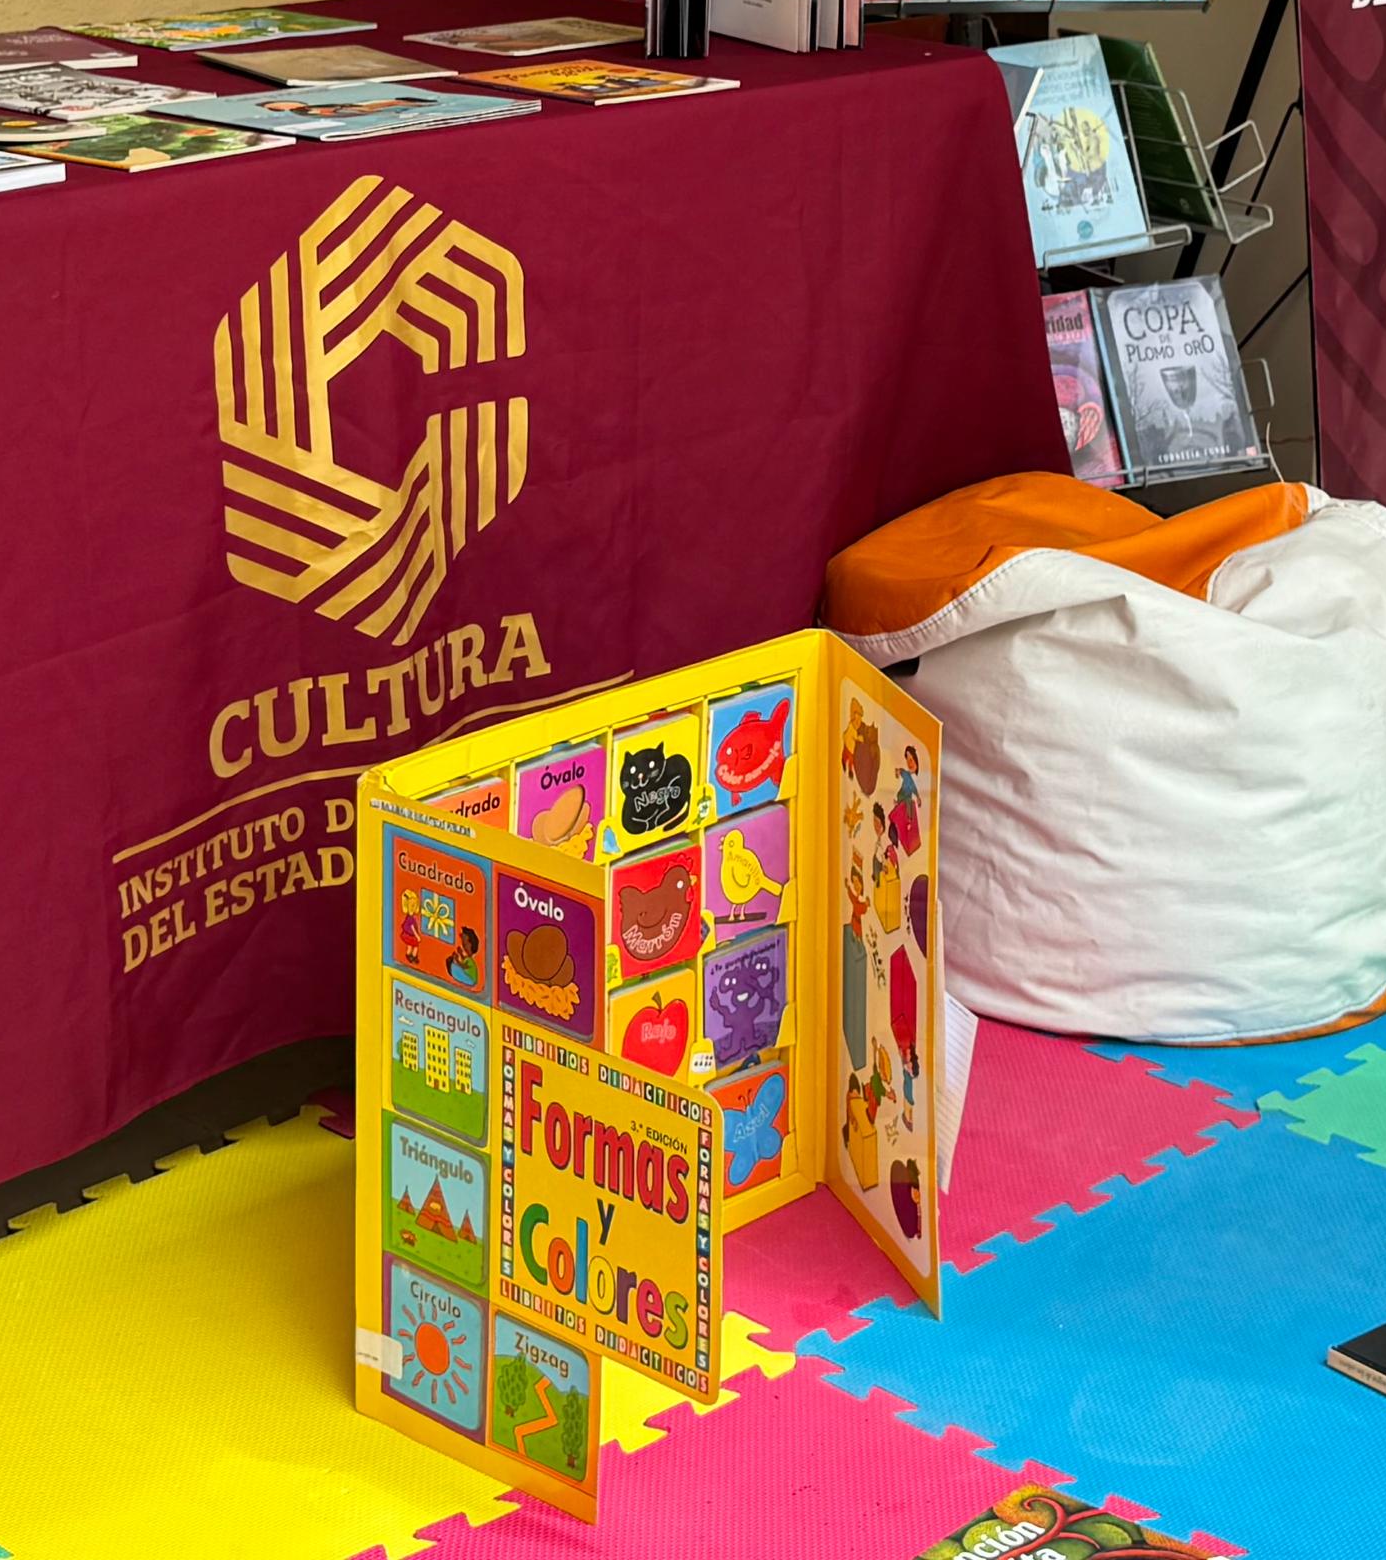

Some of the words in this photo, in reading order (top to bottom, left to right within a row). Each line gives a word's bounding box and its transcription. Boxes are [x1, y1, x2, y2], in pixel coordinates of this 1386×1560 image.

[1045, 312, 1084, 334] ridad
[1123, 300, 1205, 341] COPA
[1125, 343, 1174, 363] PLOMO
[1184, 333, 1215, 356] ORO
[208, 612, 552, 779] CULTURA
[540, 761, 585, 791] Óvalo
[633, 774, 682, 813] Negro
[118, 806, 306, 919] INSTITUTO
[325, 798, 355, 833] D
[398, 851, 474, 894] Cuadrado
[727, 851, 761, 886] Amarillo
[123, 912, 197, 974] DEL
[204, 847, 355, 928] ESTAD
[514, 881, 565, 922] Óvalo
[622, 911, 682, 954] Marrón
[394, 989, 482, 1038] Rectángulo
[641, 1016, 678, 1044] Rojo
[502, 1025, 589, 1075] LIBRITOS
[598, 1064, 712, 1128] DIDACTICOS
[503, 1046, 515, 1142] FORMAS
[519, 1059, 690, 1225] Formas
[646, 1126, 688, 1156] EDICIÓN
[732, 1102, 770, 1145] Azul
[399, 1136, 475, 1186] Triángulo
[698, 1128, 712, 1231] FORMAS
[501, 1165, 514, 1279] COLORES
[519, 1202, 689, 1350] Colores
[409, 1279, 462, 1320] Círculo
[696, 1256, 711, 1372] COLORES
[500, 1278, 586, 1335] LIBRITOS
[595, 1324, 709, 1395] DIDACTICOS
[515, 1332, 570, 1378] Zigzag
